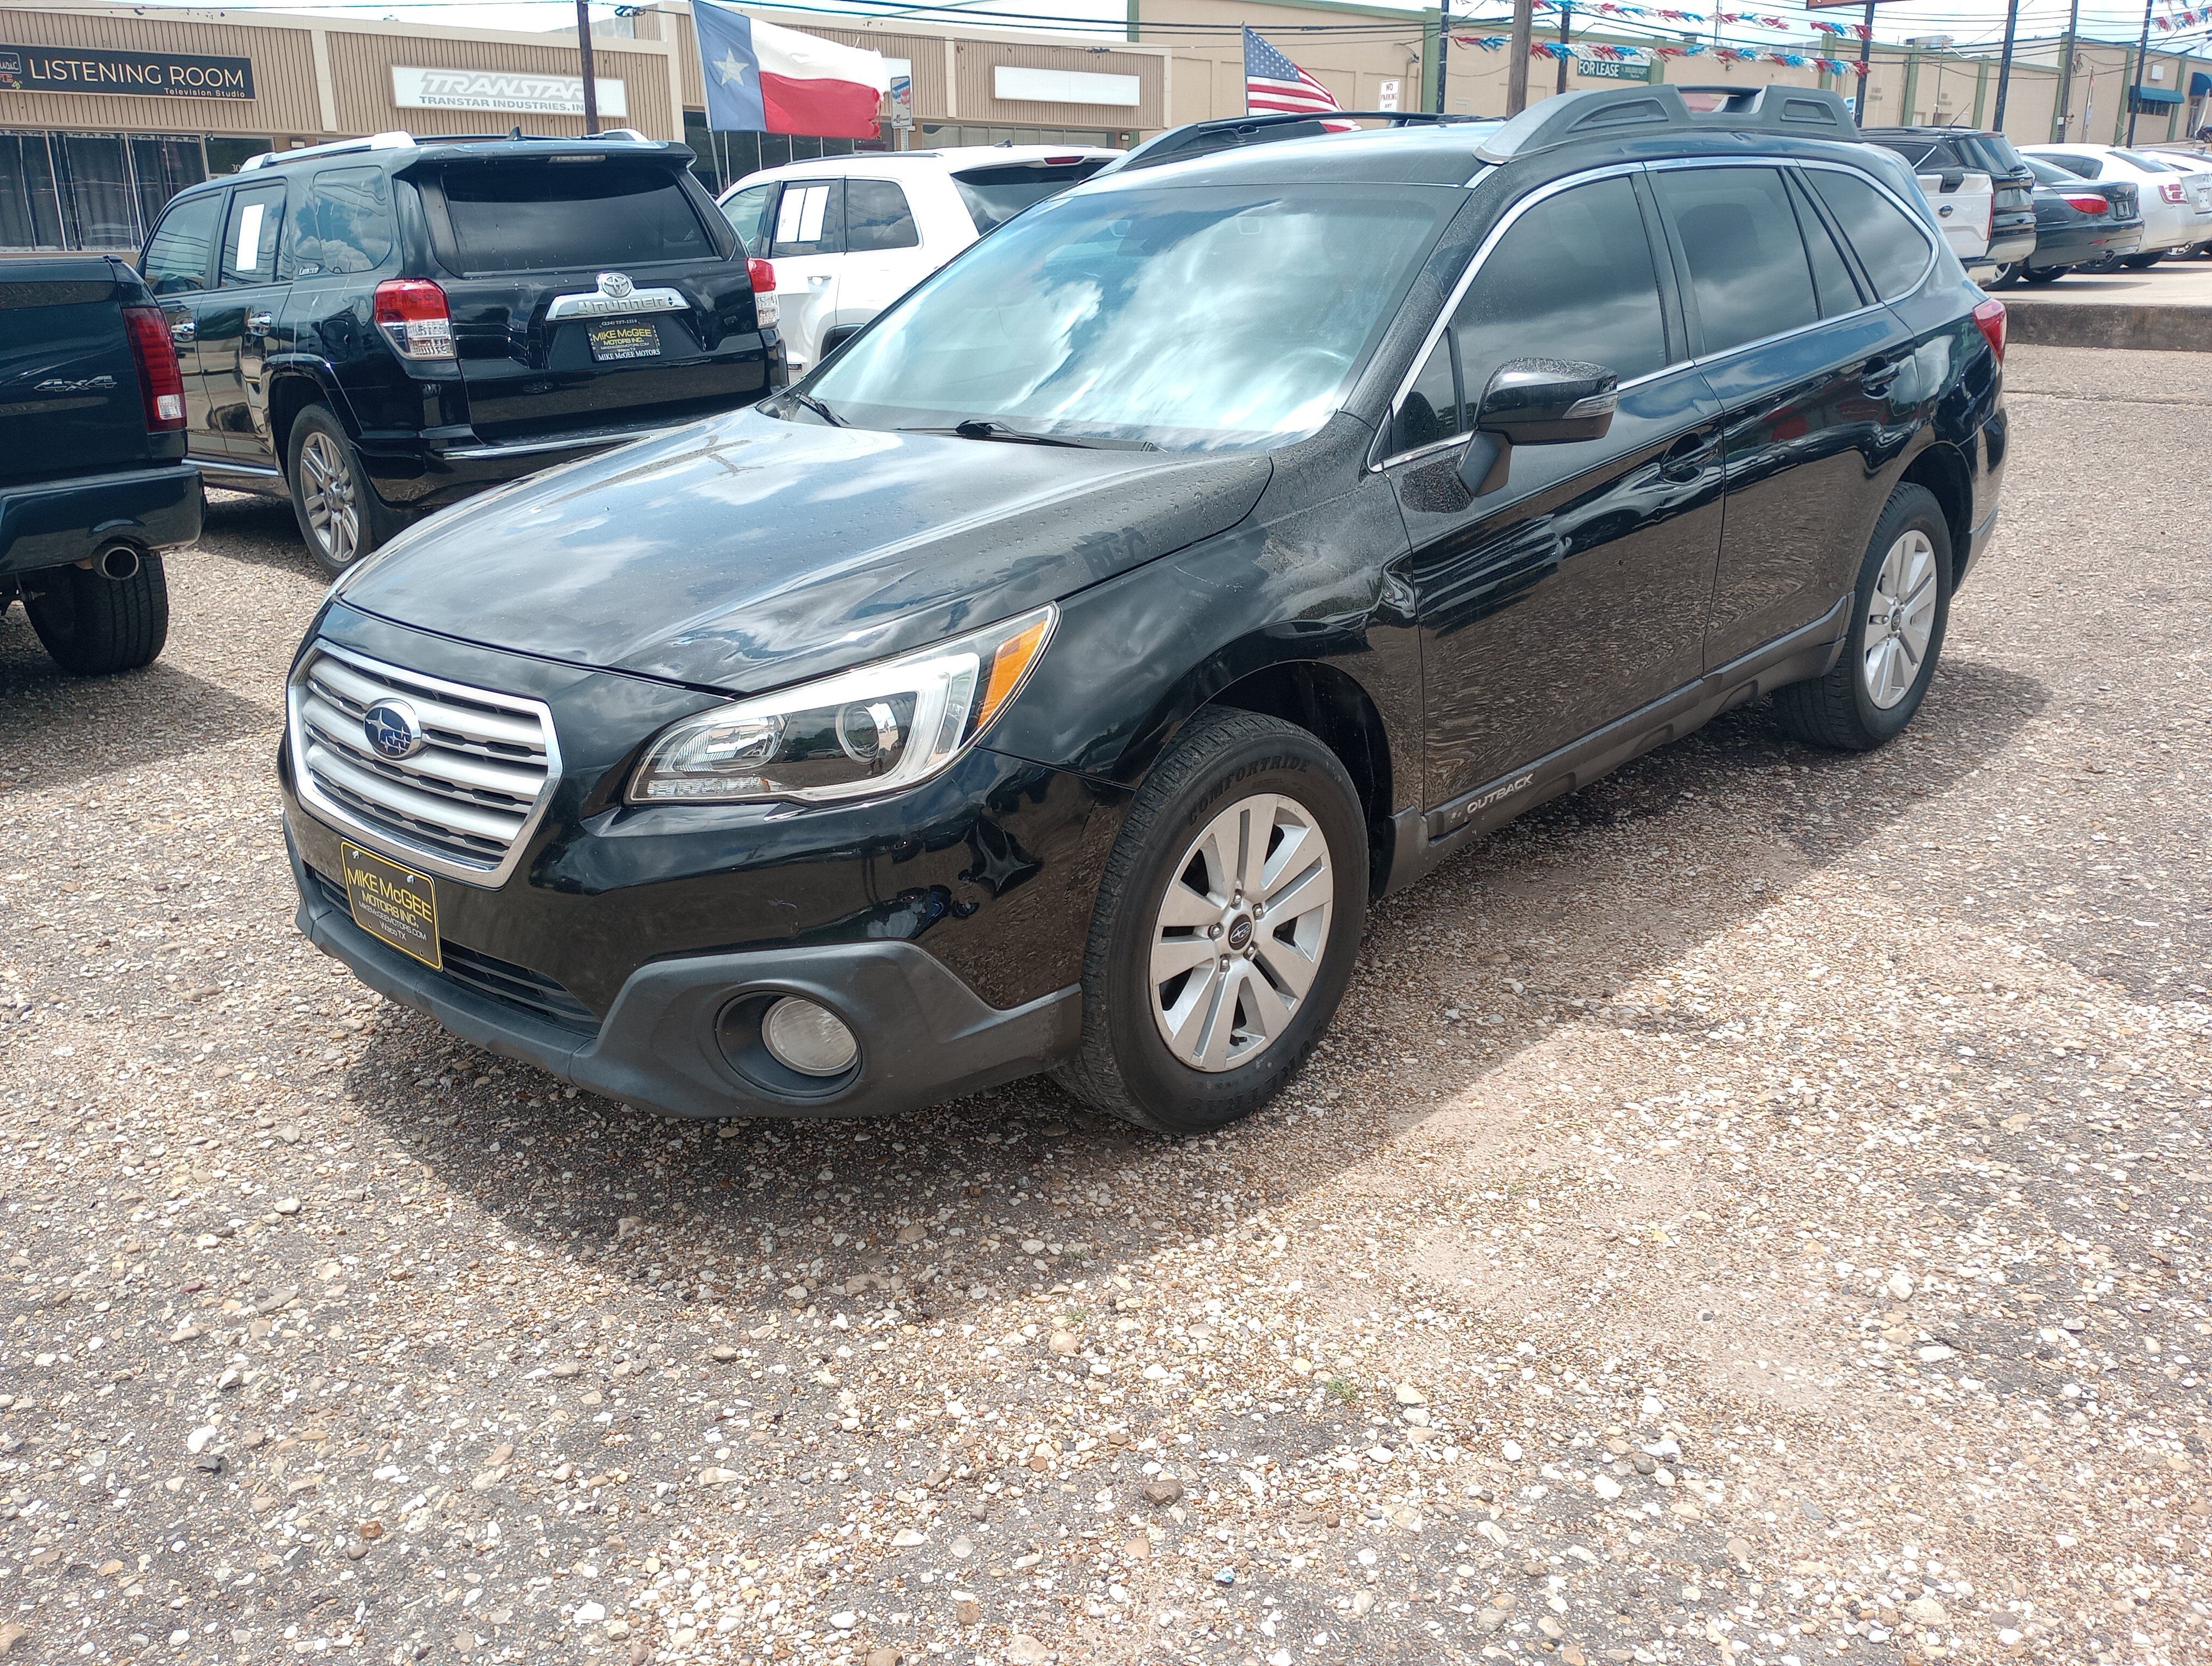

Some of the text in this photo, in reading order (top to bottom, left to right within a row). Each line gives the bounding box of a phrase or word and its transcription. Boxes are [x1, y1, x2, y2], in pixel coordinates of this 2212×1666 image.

[0, 59, 19, 71] usic
[29, 57, 162, 85] LISTENING
[169, 65, 244, 88] ROOM
[1578, 61, 1595, 74] FOR
[1596, 63, 1619, 77] LEASE
[163, 87, 246, 98] Television Studio
[1386, 83, 1393, 91] NO
[419, 96, 490, 107] TRANSTAR
[592, 328, 653, 342] MIKE McGEE
[614, 351, 635, 359] McGEE
[635, 348, 660, 358] MOTORS
[1467, 773, 1533, 814] OUTBACK
[347, 868, 433, 924] MIKE McGEE
[361, 889, 399, 919] MOTORS
[380, 921, 407, 941] Waco TX
